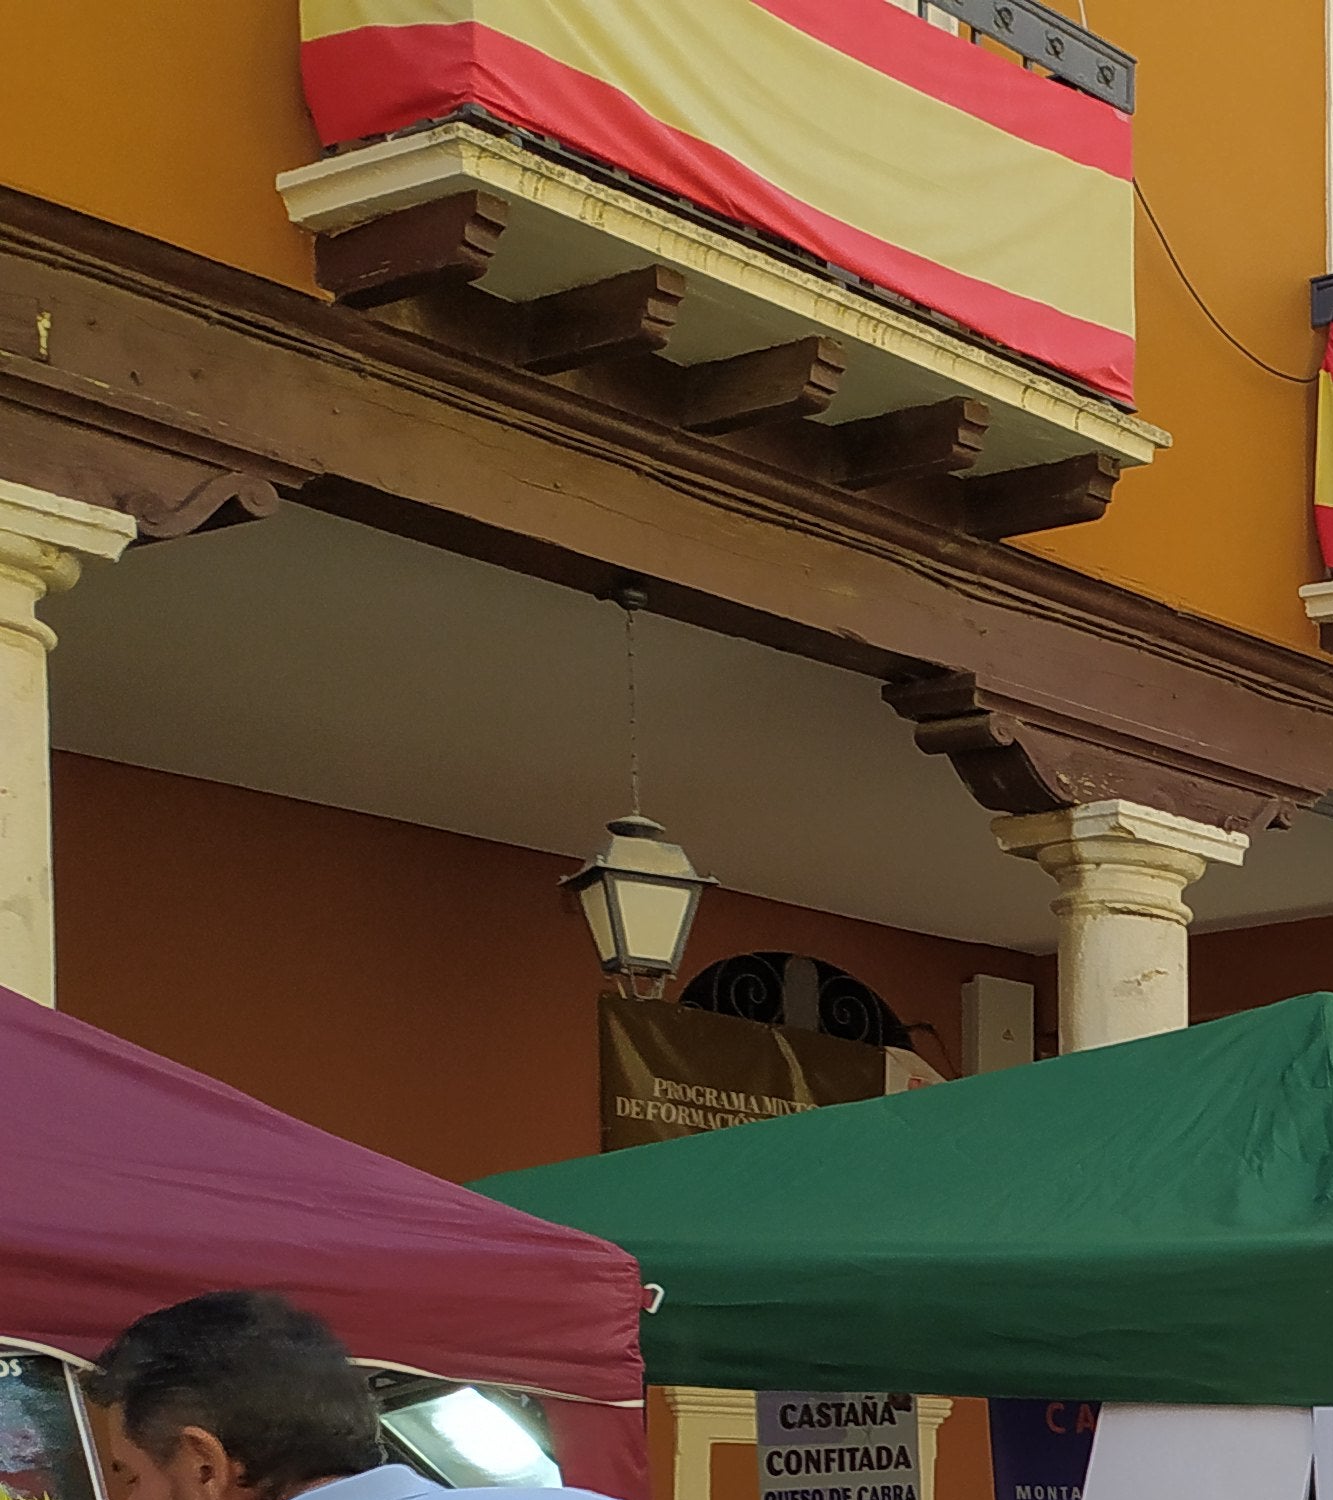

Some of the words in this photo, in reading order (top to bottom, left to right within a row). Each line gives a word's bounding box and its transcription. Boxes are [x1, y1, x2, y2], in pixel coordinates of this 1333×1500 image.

[616, 1096, 647, 1119] DE
[646, 1101, 761, 1129] FORMACIÓ
[653, 1077, 761, 1114] PROGRAMA
[762, 1096, 819, 1116] MIXT
[779, 1395, 897, 1429] CASTAÑA
[1045, 1402, 1097, 1434] CA
[766, 1445, 912, 1477] CONFITADA
[1015, 1485, 1083, 1500] MONTA
